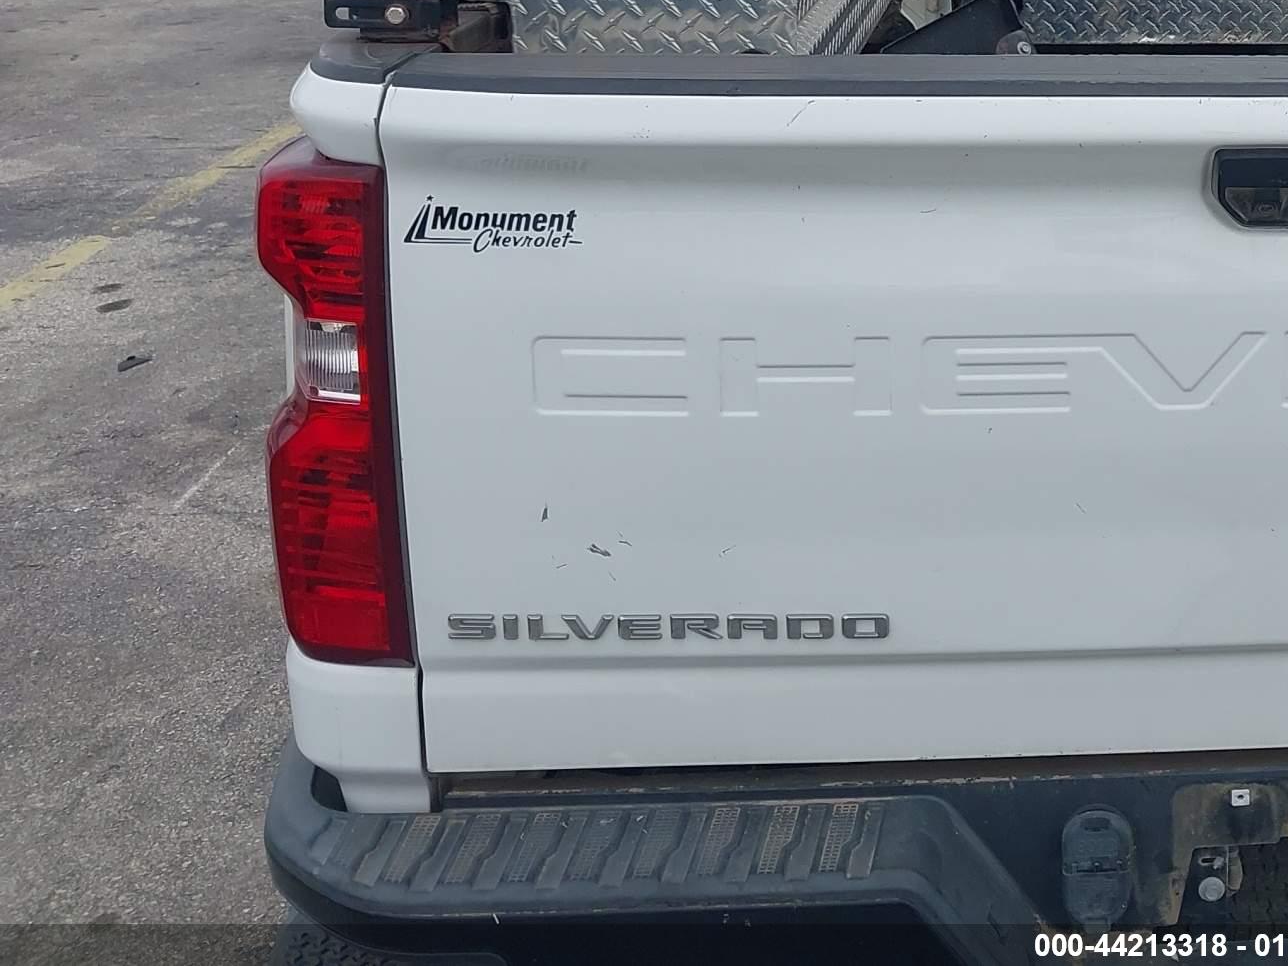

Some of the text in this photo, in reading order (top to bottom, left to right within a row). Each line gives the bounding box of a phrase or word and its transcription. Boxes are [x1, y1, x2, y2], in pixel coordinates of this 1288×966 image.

[431, 206, 578, 233] Monument
[473, 228, 583, 253] Chevrolet
[447, 613, 890, 641] SILVERADO
